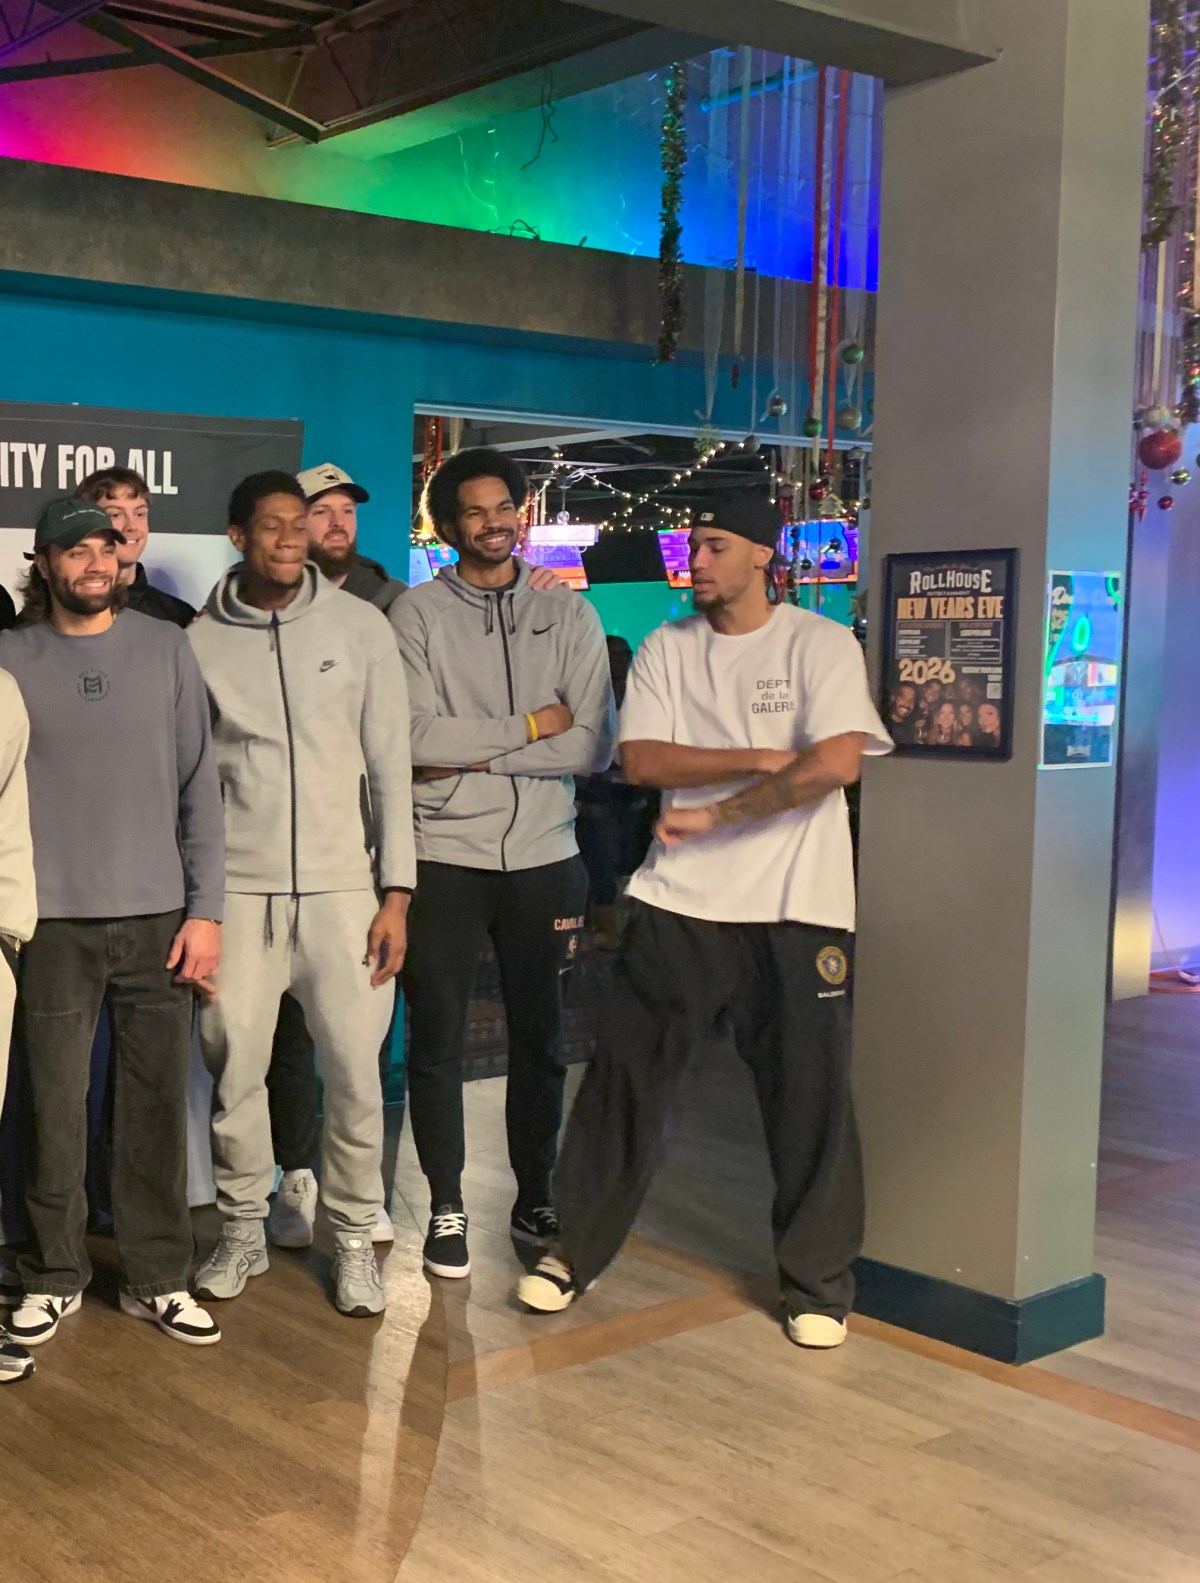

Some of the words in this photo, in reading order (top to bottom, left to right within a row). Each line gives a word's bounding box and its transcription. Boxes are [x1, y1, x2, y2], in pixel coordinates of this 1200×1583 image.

[127, 448, 179, 495] ALL
[897, 598, 928, 619] NEW
[930, 597, 975, 619] YEARS
[978, 596, 1004, 618] EVE
[899, 656, 956, 684] 2026
[761, 691, 775, 701] de
[780, 690, 789, 700] la
